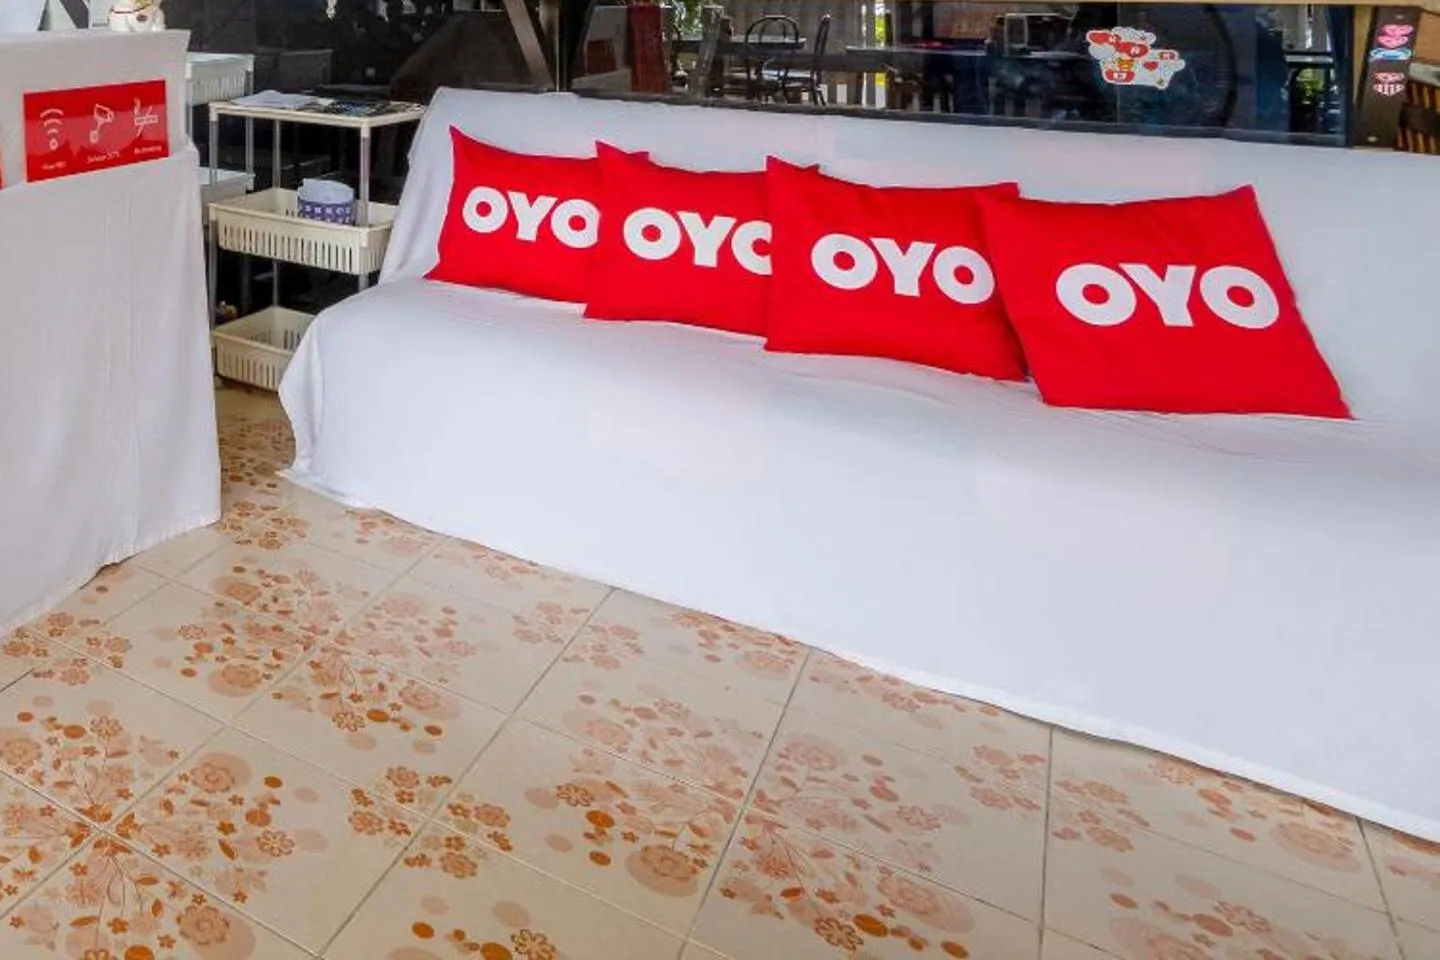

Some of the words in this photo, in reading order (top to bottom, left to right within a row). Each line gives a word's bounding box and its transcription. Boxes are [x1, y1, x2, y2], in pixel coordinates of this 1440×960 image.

[462, 185, 598, 250] OYO
[811, 233, 995, 304] OYO
[1056, 262, 1280, 330] OYO
